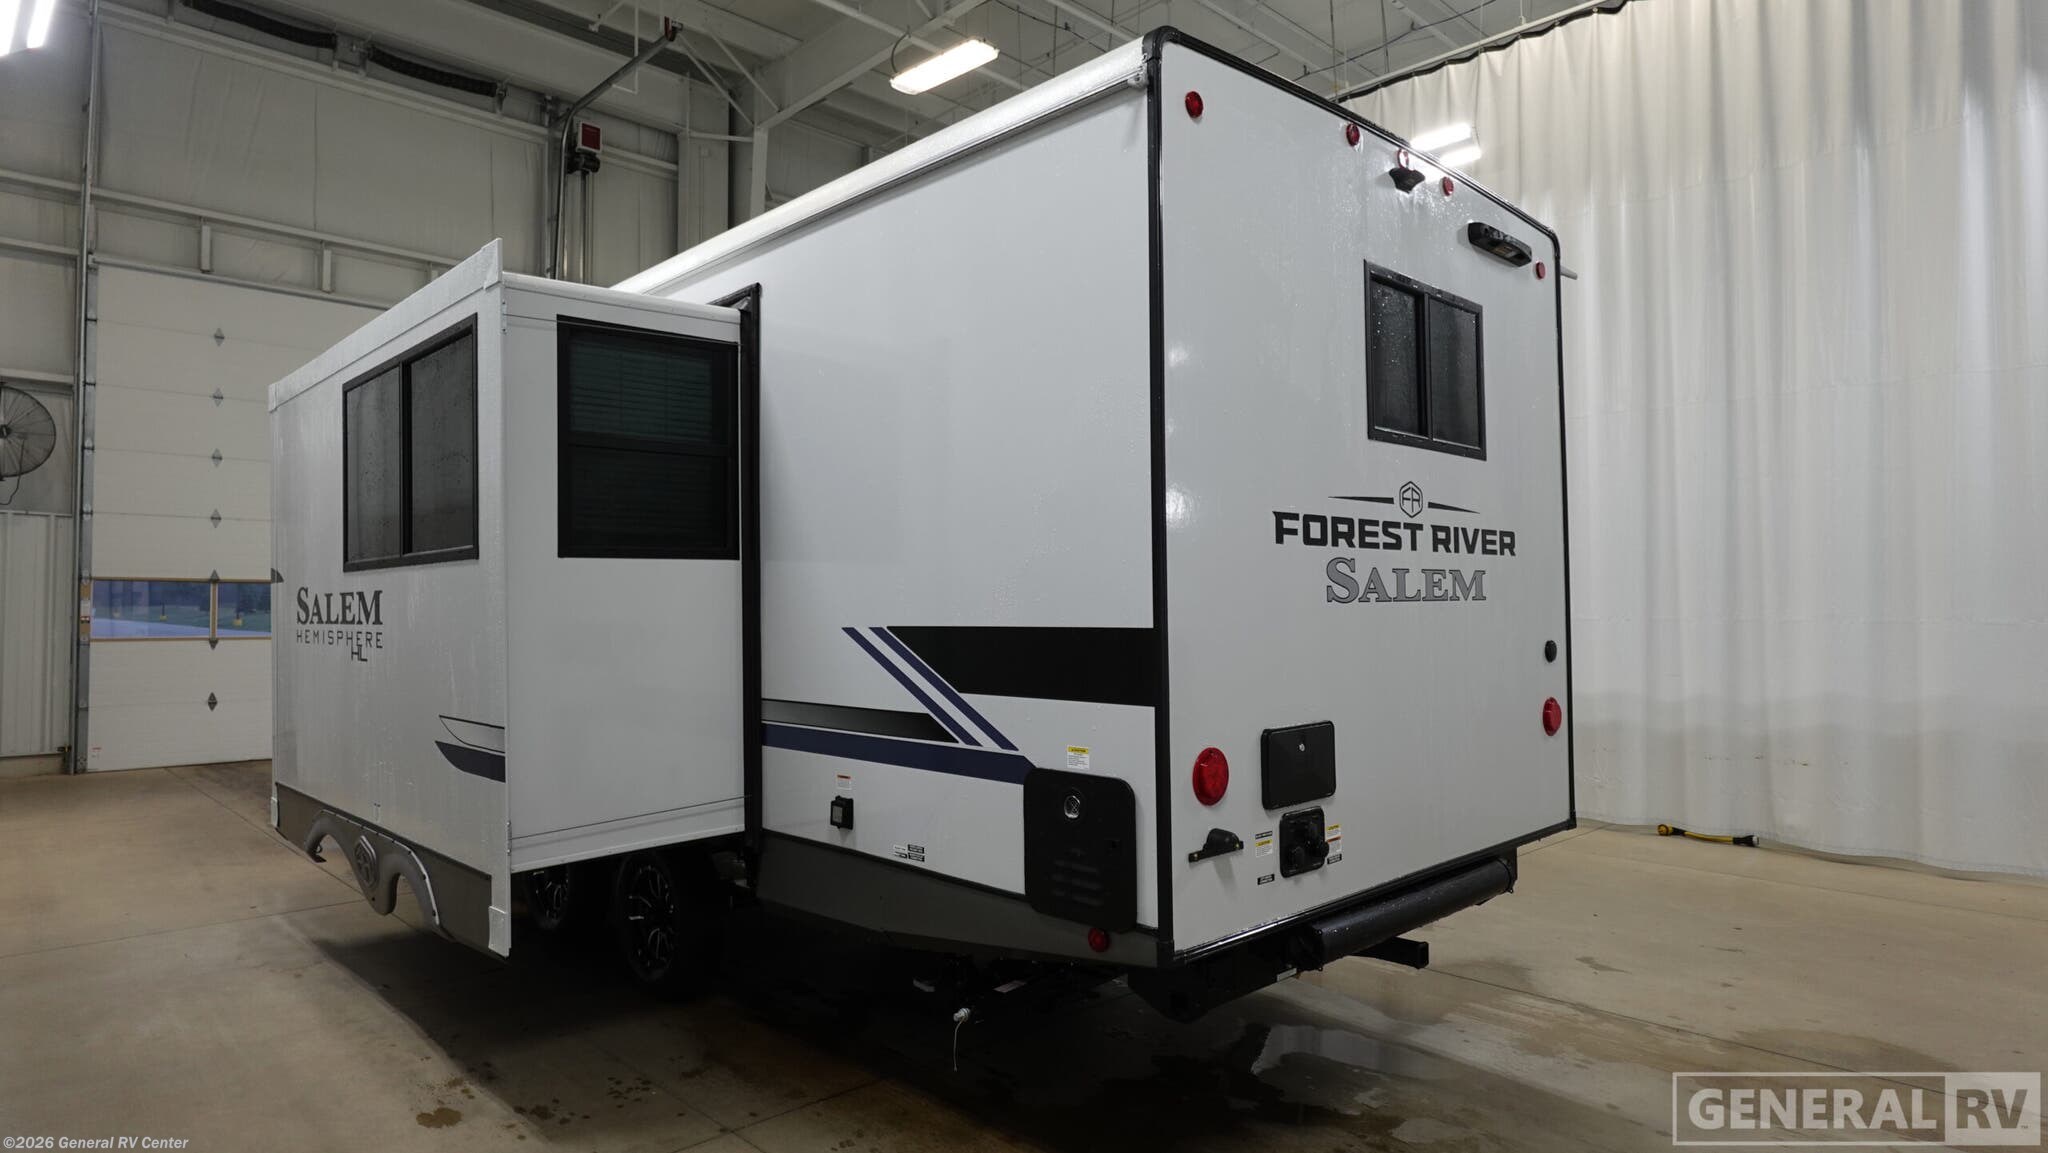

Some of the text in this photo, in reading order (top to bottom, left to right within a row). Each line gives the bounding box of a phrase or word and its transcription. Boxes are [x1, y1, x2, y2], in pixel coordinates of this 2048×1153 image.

[1272, 510, 1516, 556] FOREST RIVER
[1326, 557, 1487, 604] SALEM
[296, 586, 383, 625] SALEM
[296, 629, 383, 649] HEMISPHERE
